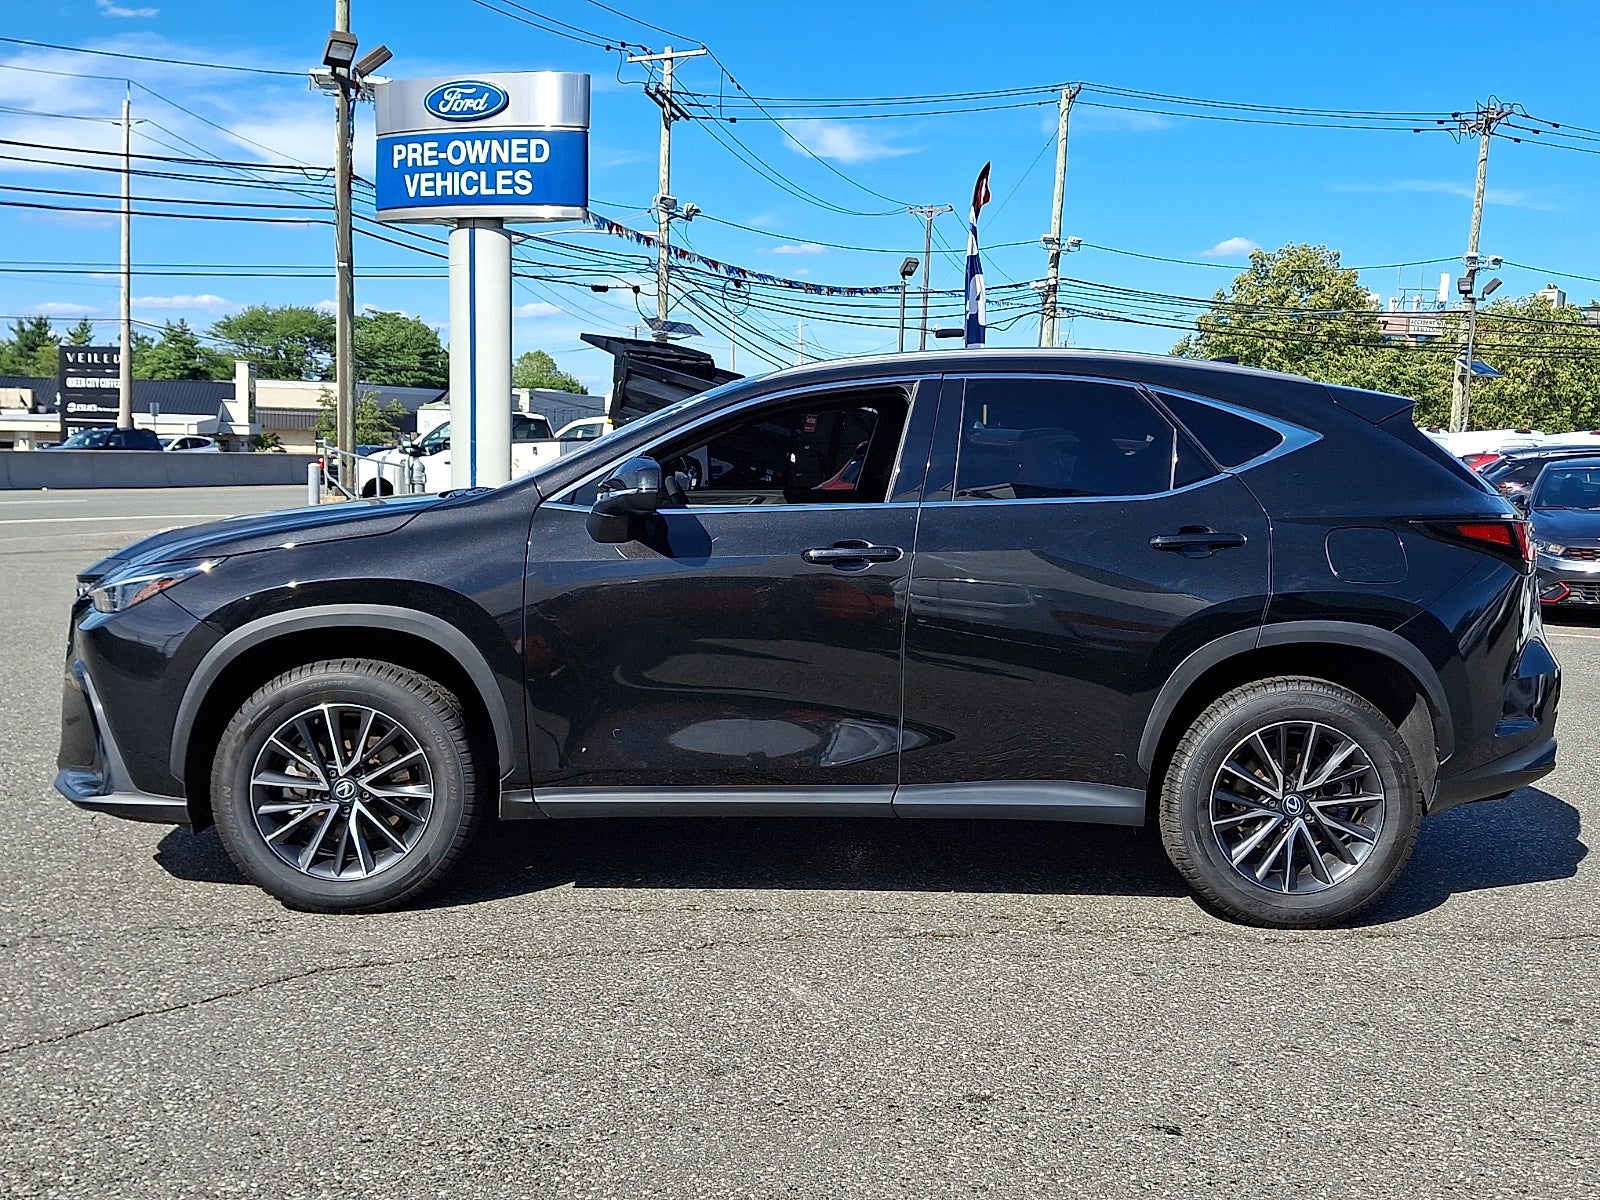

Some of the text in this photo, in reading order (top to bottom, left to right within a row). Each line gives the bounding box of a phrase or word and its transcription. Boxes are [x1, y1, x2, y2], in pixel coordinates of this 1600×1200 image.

[438, 87, 490, 113] Ford
[392, 138, 550, 169] PRE-OWNED
[404, 169, 533, 198] VEHICLES
[86, 377, 100, 388] CITY
